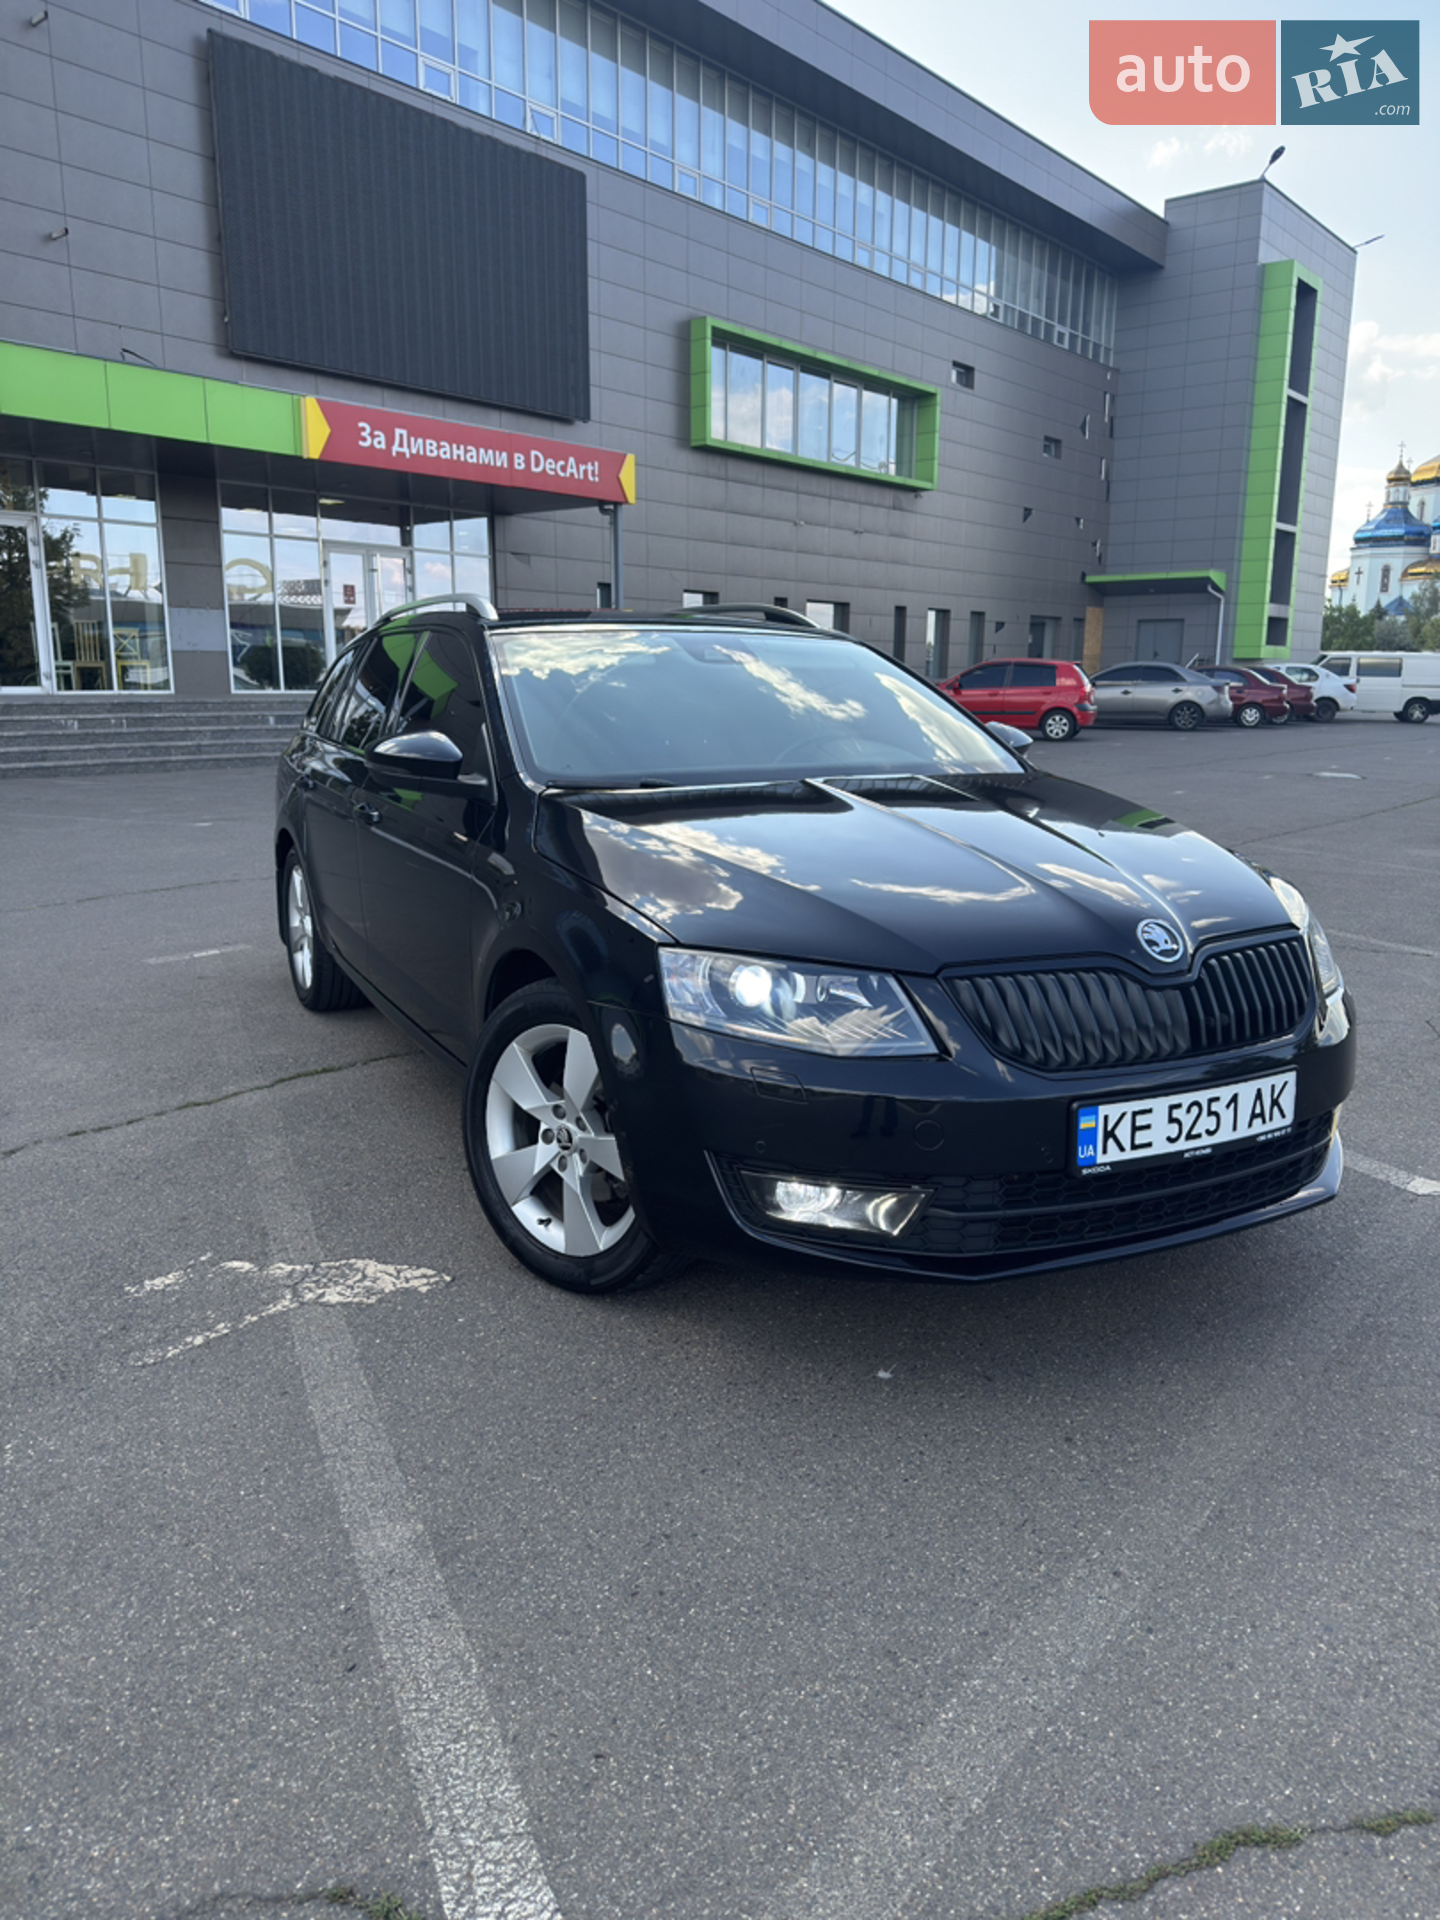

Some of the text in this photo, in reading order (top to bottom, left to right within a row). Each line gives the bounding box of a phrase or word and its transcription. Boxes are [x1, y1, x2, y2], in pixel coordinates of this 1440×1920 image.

[357, 421, 601, 482] За Диванами в DecArt!
[1101, 1080, 1290, 1156] KE 5251 AK
[1078, 1144, 1096, 1159] UA
